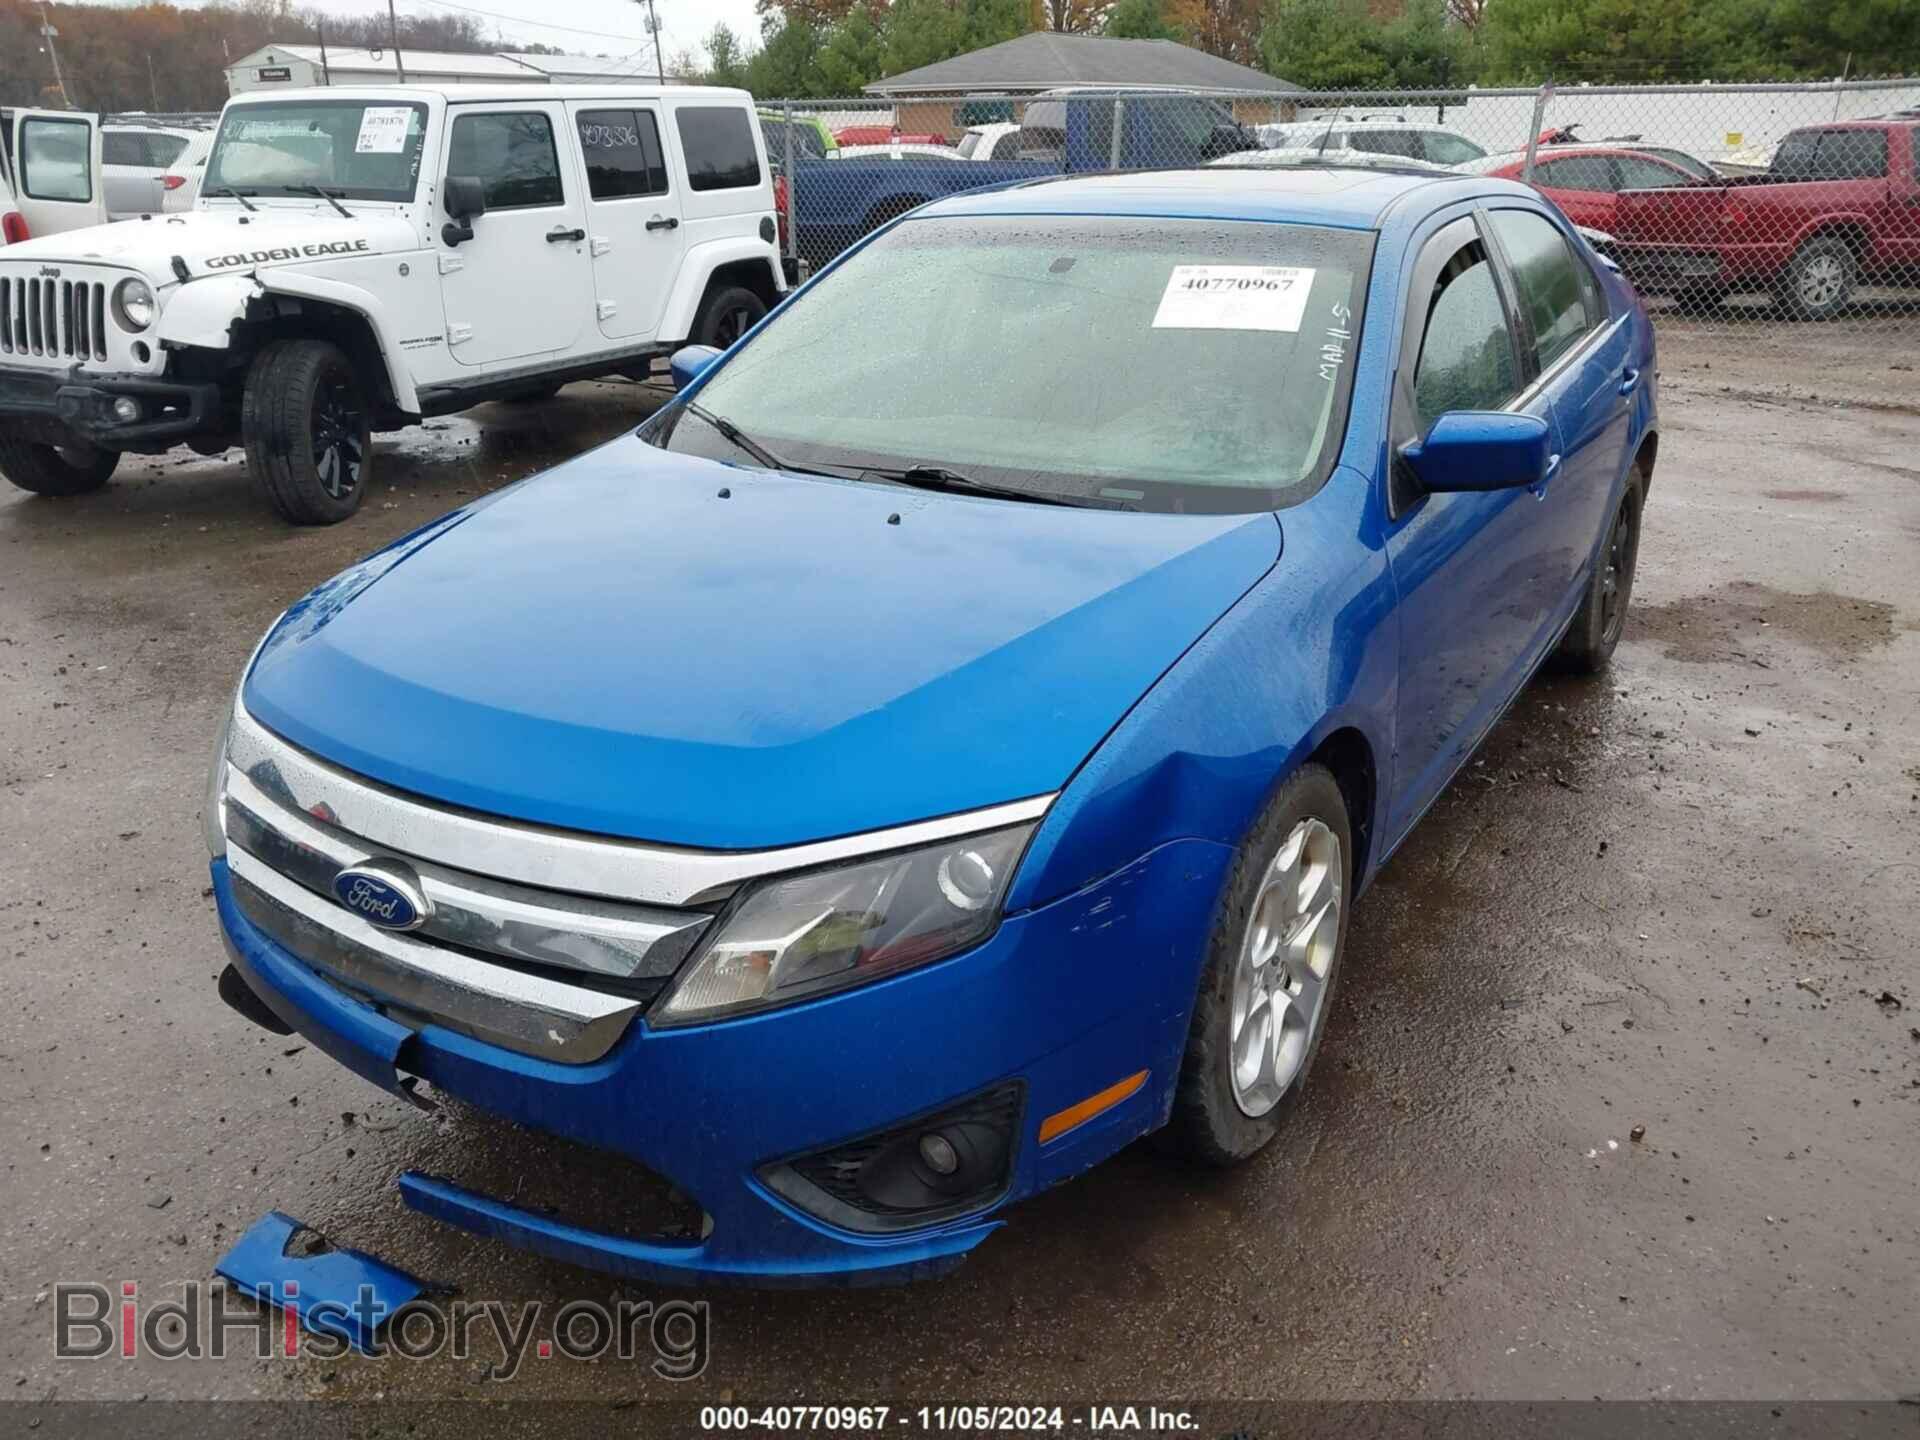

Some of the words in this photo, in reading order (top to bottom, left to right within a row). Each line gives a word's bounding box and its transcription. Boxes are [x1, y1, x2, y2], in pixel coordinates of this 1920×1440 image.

[205, 247, 300, 268] GOLDEN
[302, 239, 369, 257] EAGLE
[1181, 278, 1294, 291] 40770967
[348, 878, 398, 919] Ford
